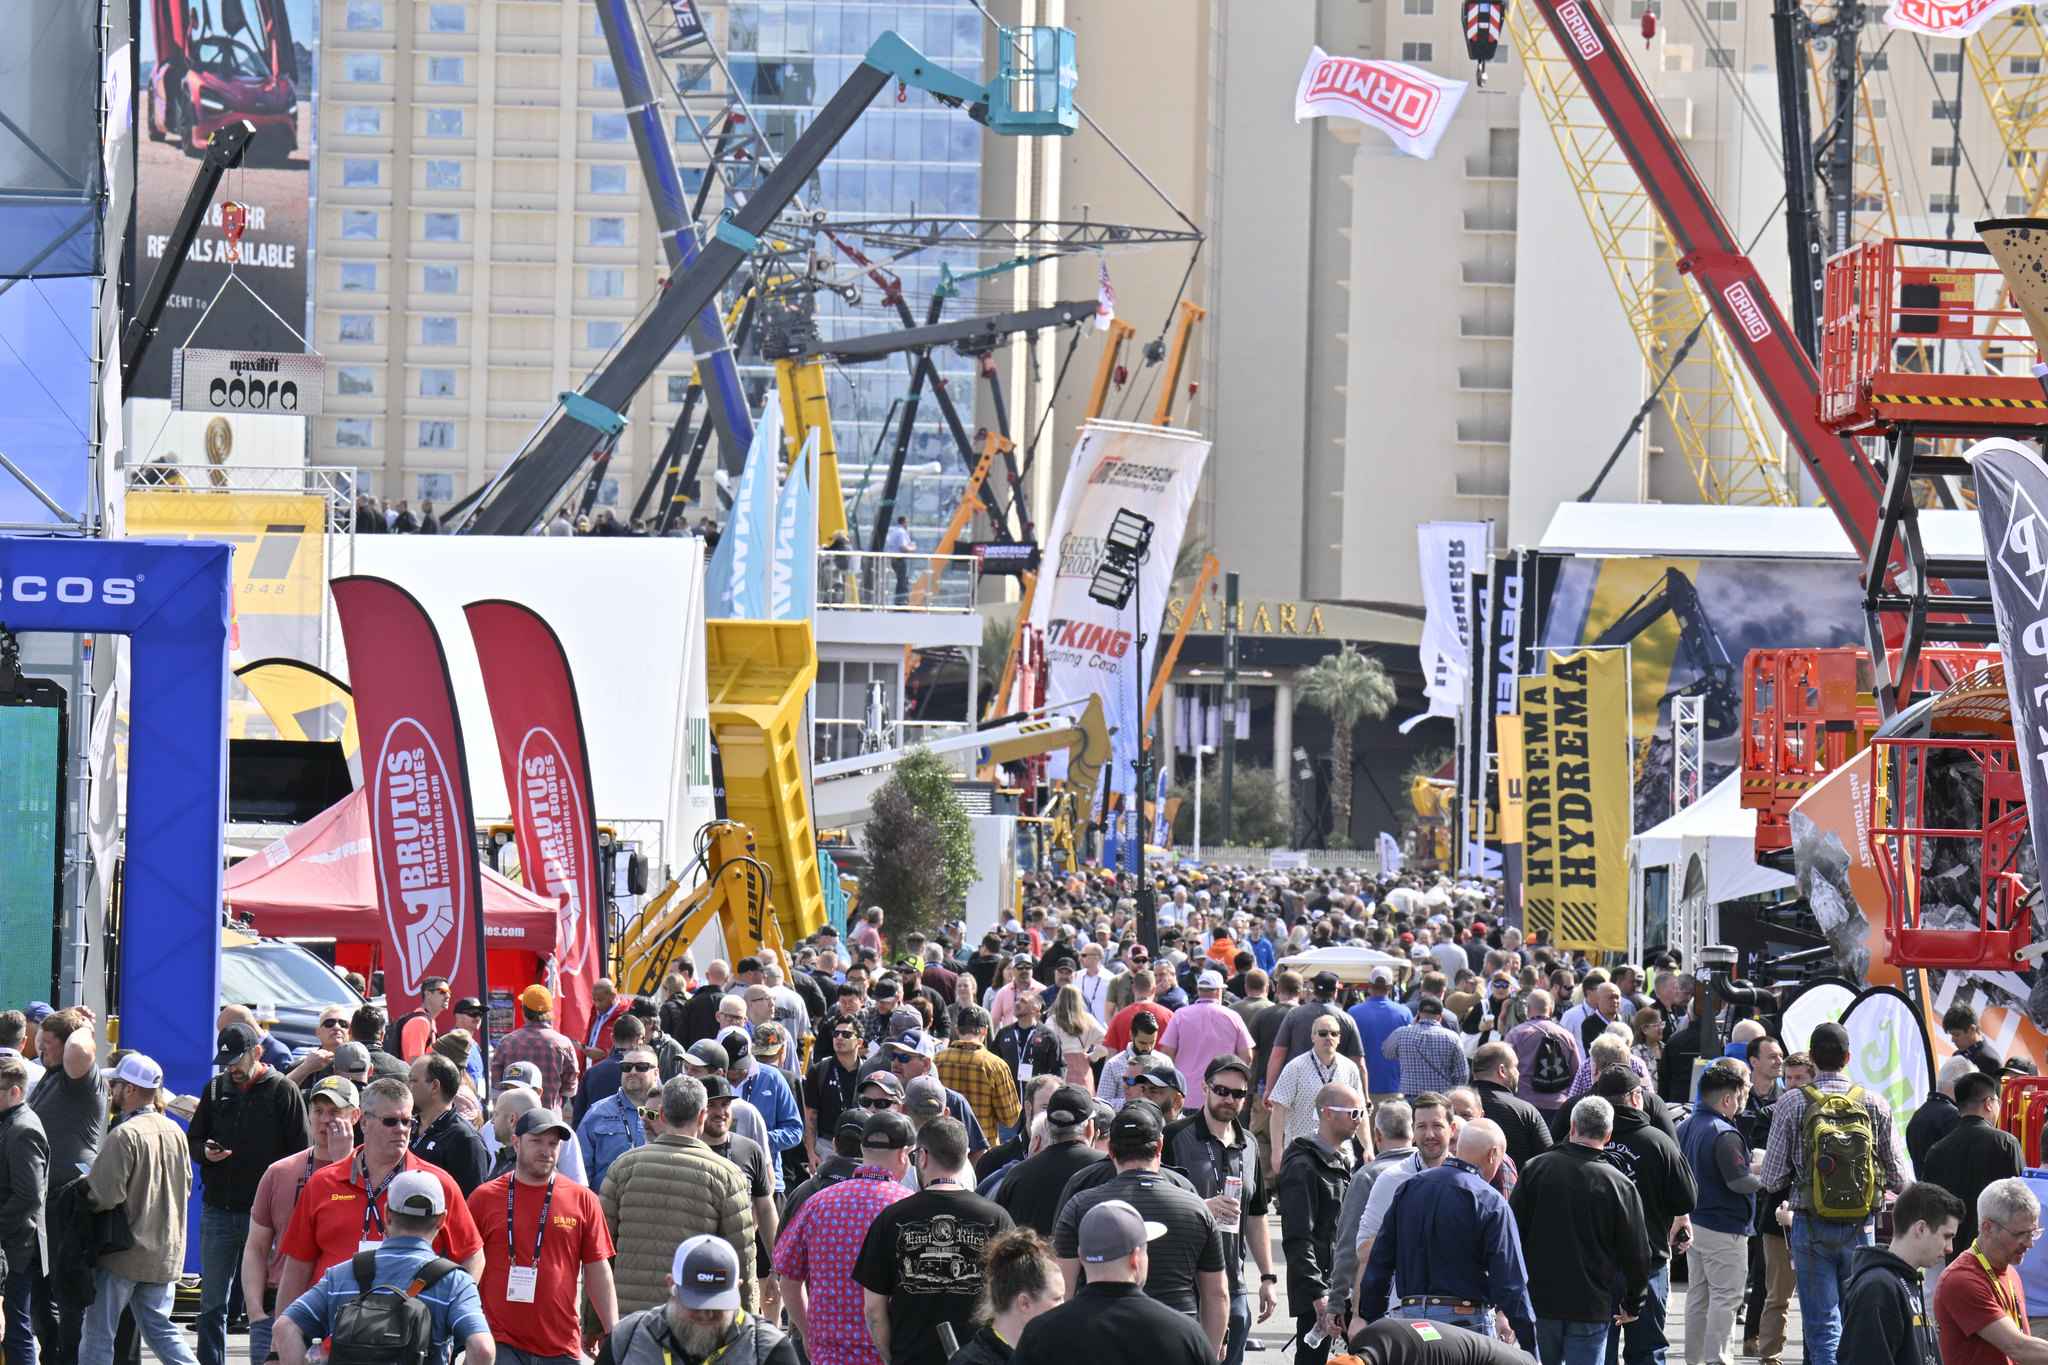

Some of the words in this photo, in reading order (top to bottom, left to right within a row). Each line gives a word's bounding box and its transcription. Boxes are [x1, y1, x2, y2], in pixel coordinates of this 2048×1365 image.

[1563, 3, 1599, 57] ORMIG
[1314, 61, 1429, 124] ORMIG
[147, 235, 212, 263] REALS
[248, 206, 266, 230] HR
[167, 294, 193, 309] CENT
[1730, 285, 1766, 338] ORMIG
[209, 374, 298, 411] cobra
[1167, 598, 1326, 634] SAHARA
[1497, 576, 1524, 715] DEVEL
[412, 747, 433, 818] BODIES
[544, 753, 562, 817] BODIES
[1524, 685, 1554, 888] HYDREMA
[1553, 655, 1597, 889] HYDREMA
[387, 750, 428, 890] BRUTUS
[430, 774, 450, 885] brutusbodies.com
[525, 756, 564, 882] BRUTUS
[1854, 801, 1872, 870] TOUGHEST
[421, 821, 438, 887] TRUCK
